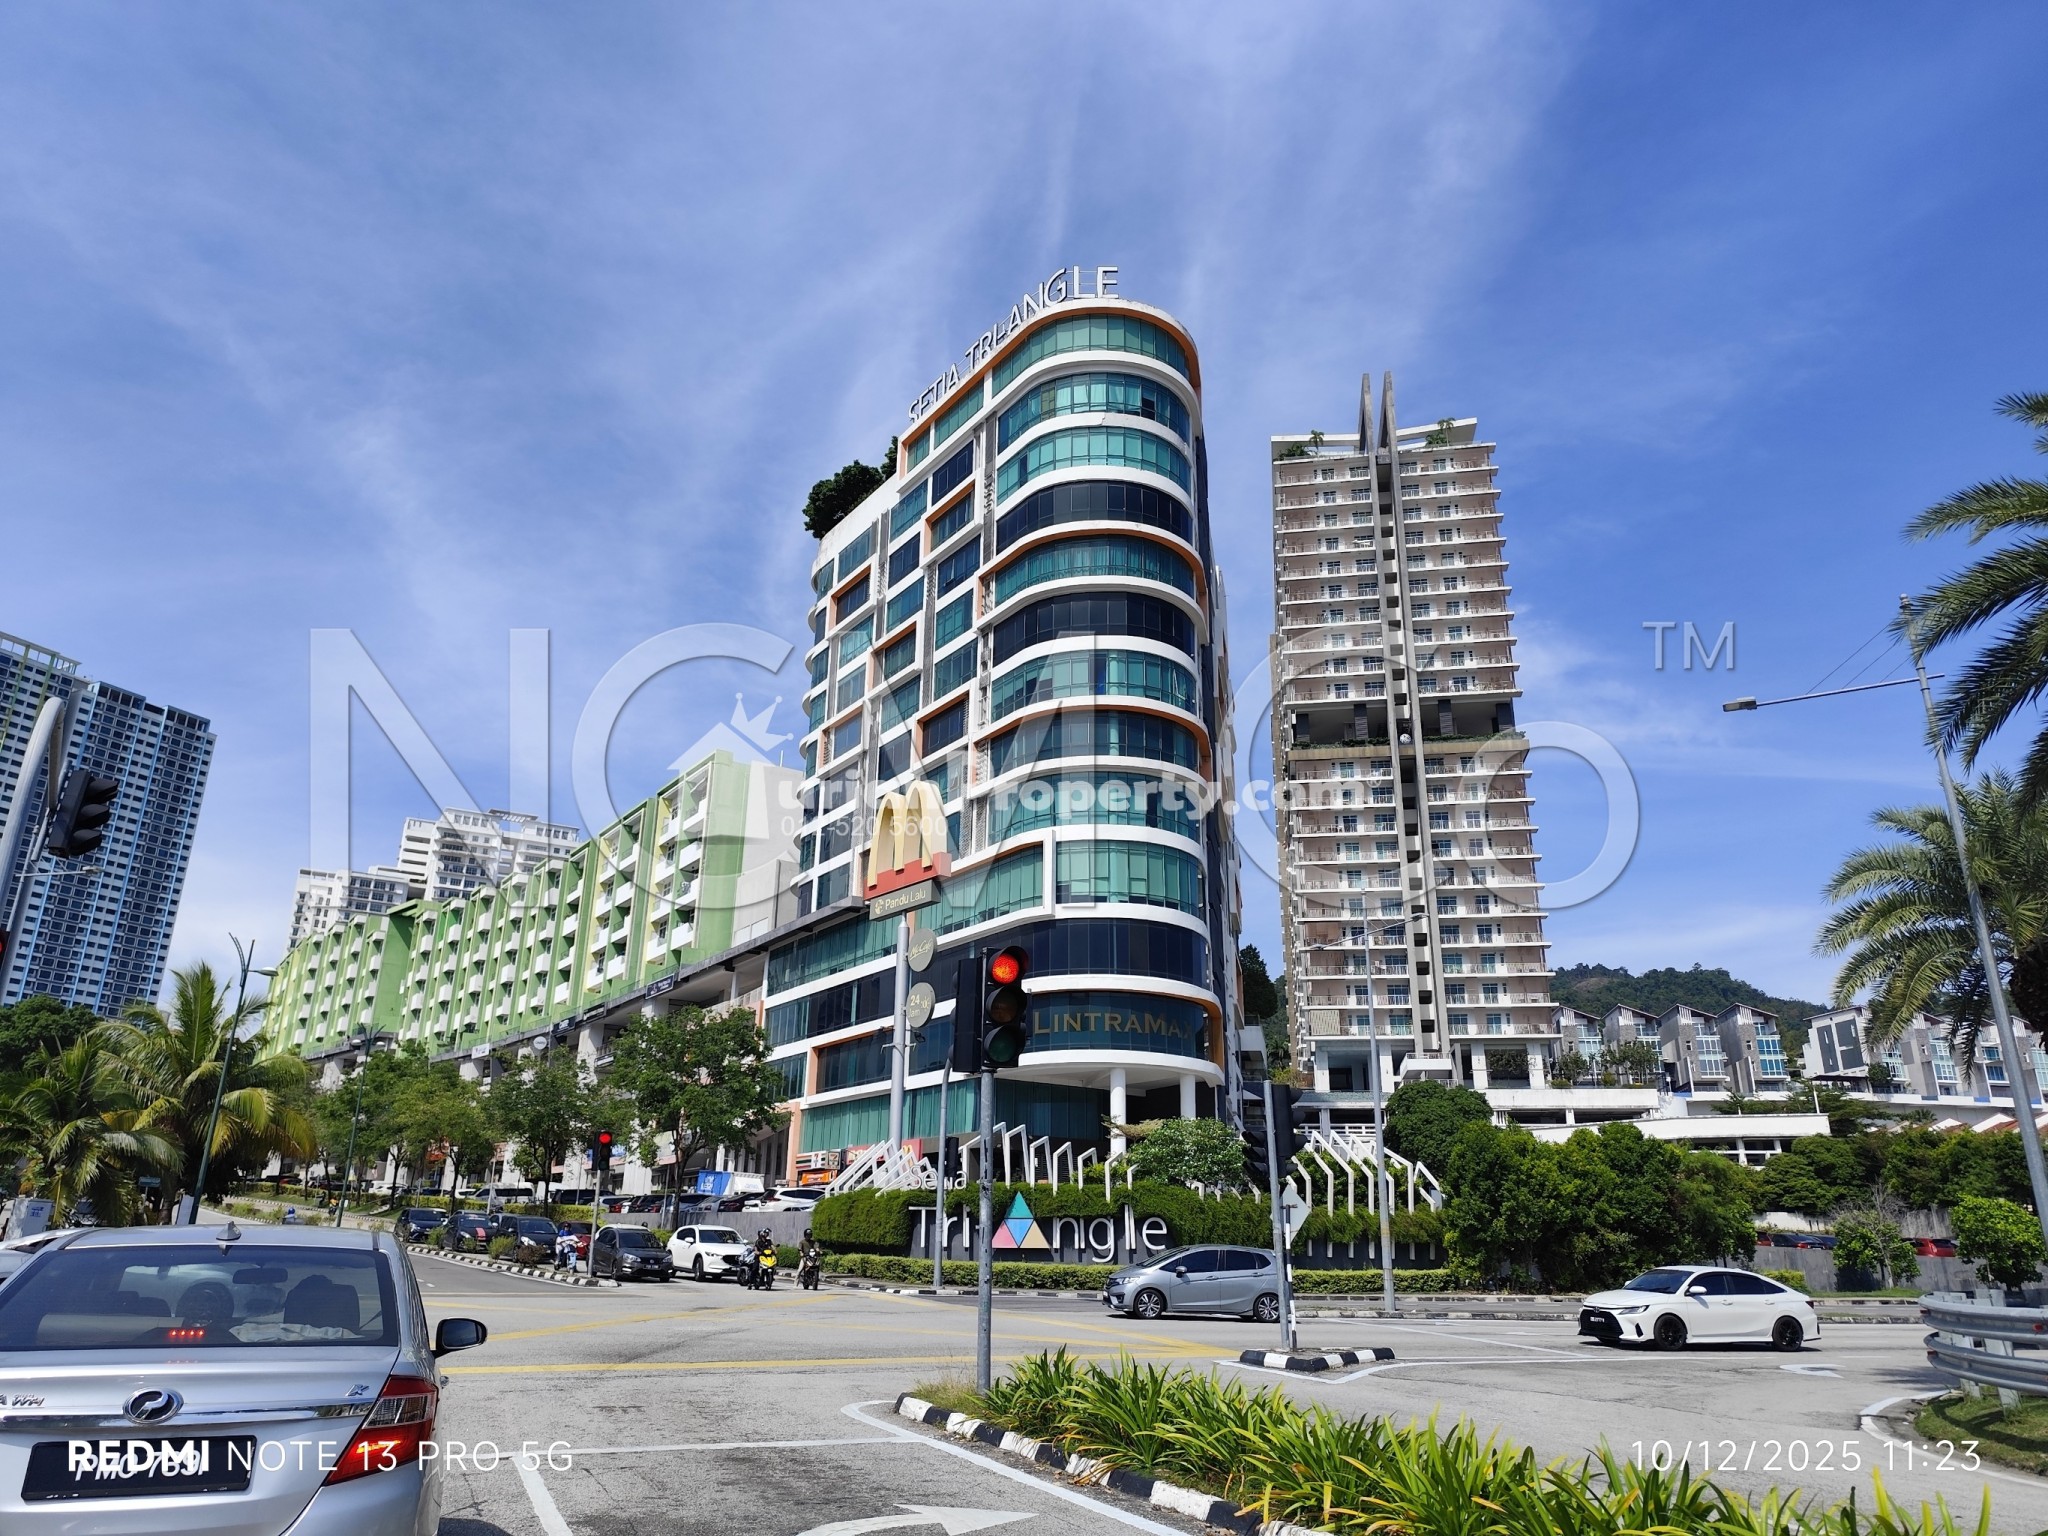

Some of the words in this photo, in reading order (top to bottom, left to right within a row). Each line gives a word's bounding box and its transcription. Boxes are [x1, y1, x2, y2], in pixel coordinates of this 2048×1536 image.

[908, 363, 960, 423] SETIA
[965, 265, 1119, 371] TRIANGLE
[885, 892, 909, 910] Pandu
[910, 888, 926, 902] Lalu
[910, 994, 920, 1005] 24
[909, 1165, 968, 1190] Seia
